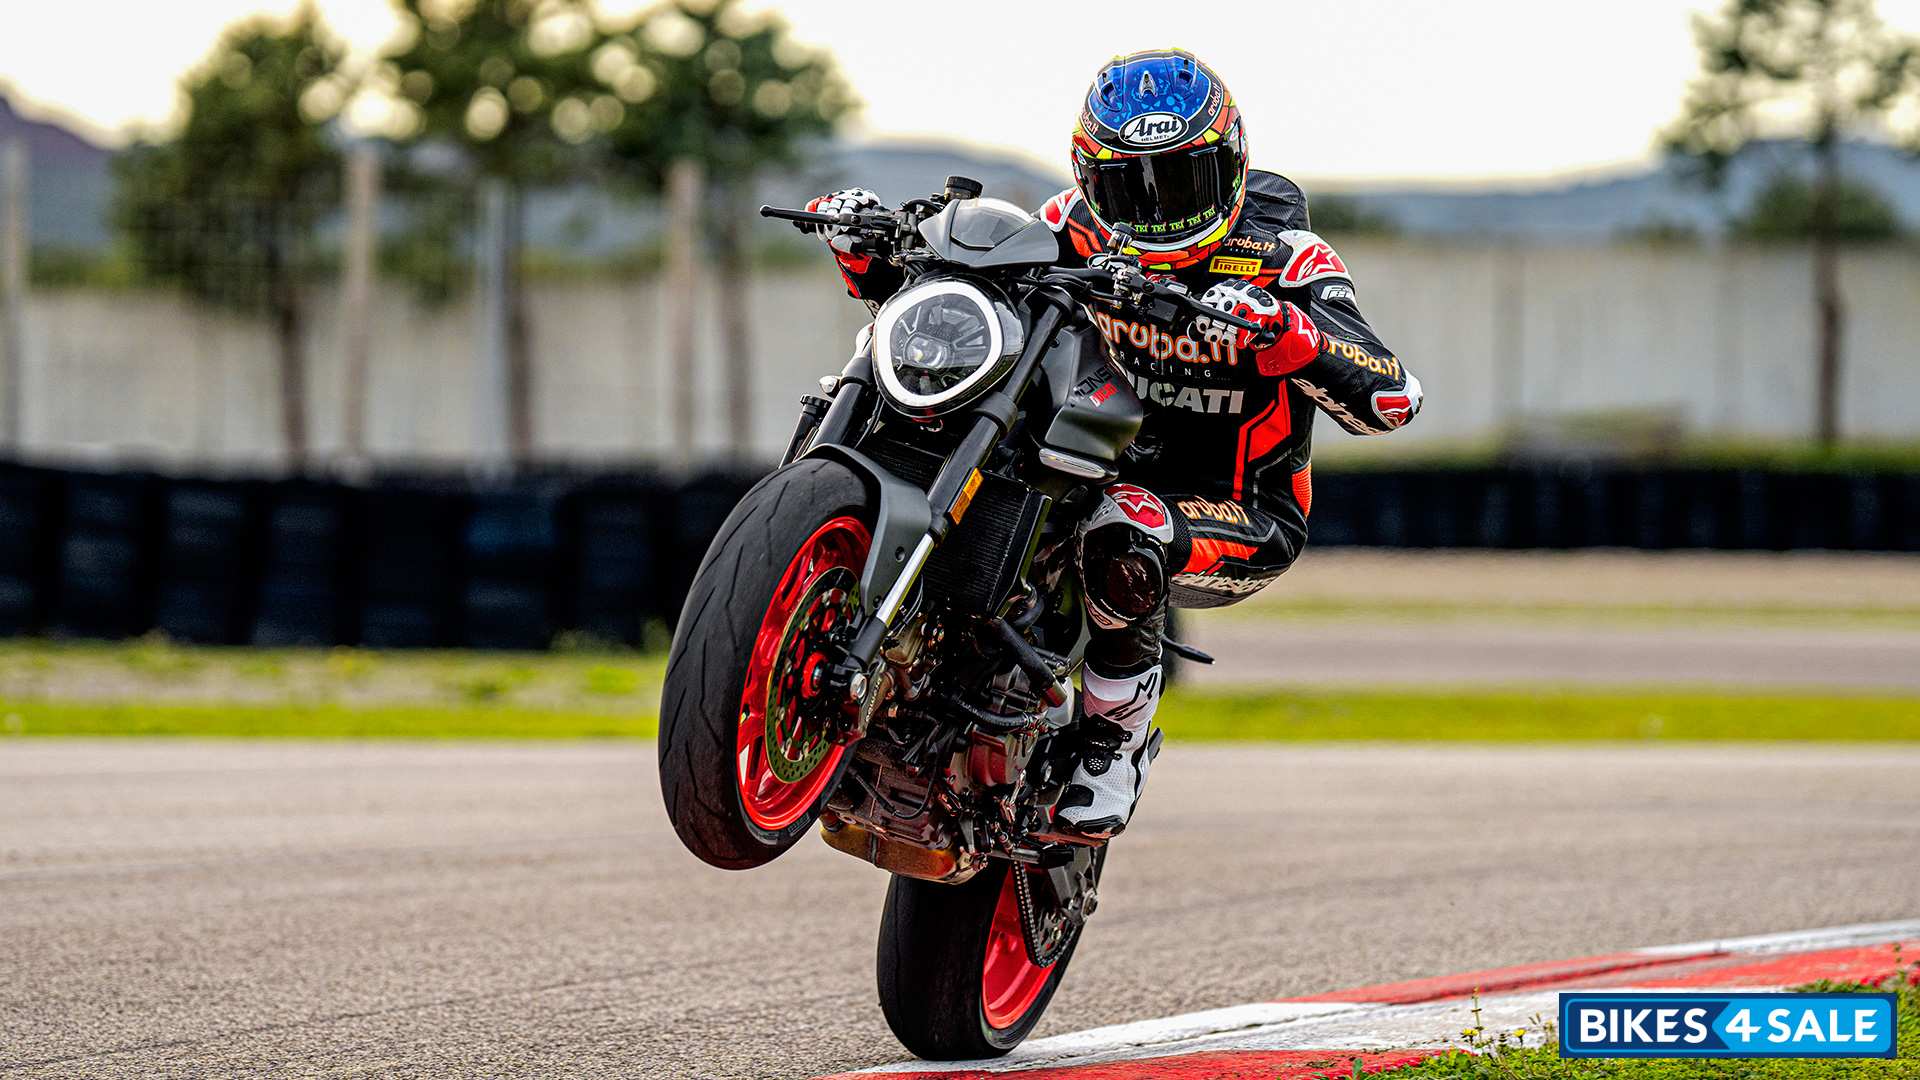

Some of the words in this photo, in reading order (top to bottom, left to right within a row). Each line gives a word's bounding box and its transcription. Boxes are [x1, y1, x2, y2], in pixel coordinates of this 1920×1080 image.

[1124, 116, 1180, 140] Arai
[1213, 258, 1258, 273] PIRELLI
[1119, 350, 1212, 378] RACING
[1328, 340, 1401, 381] ruba.it
[1127, 370, 1245, 414] UCATI
